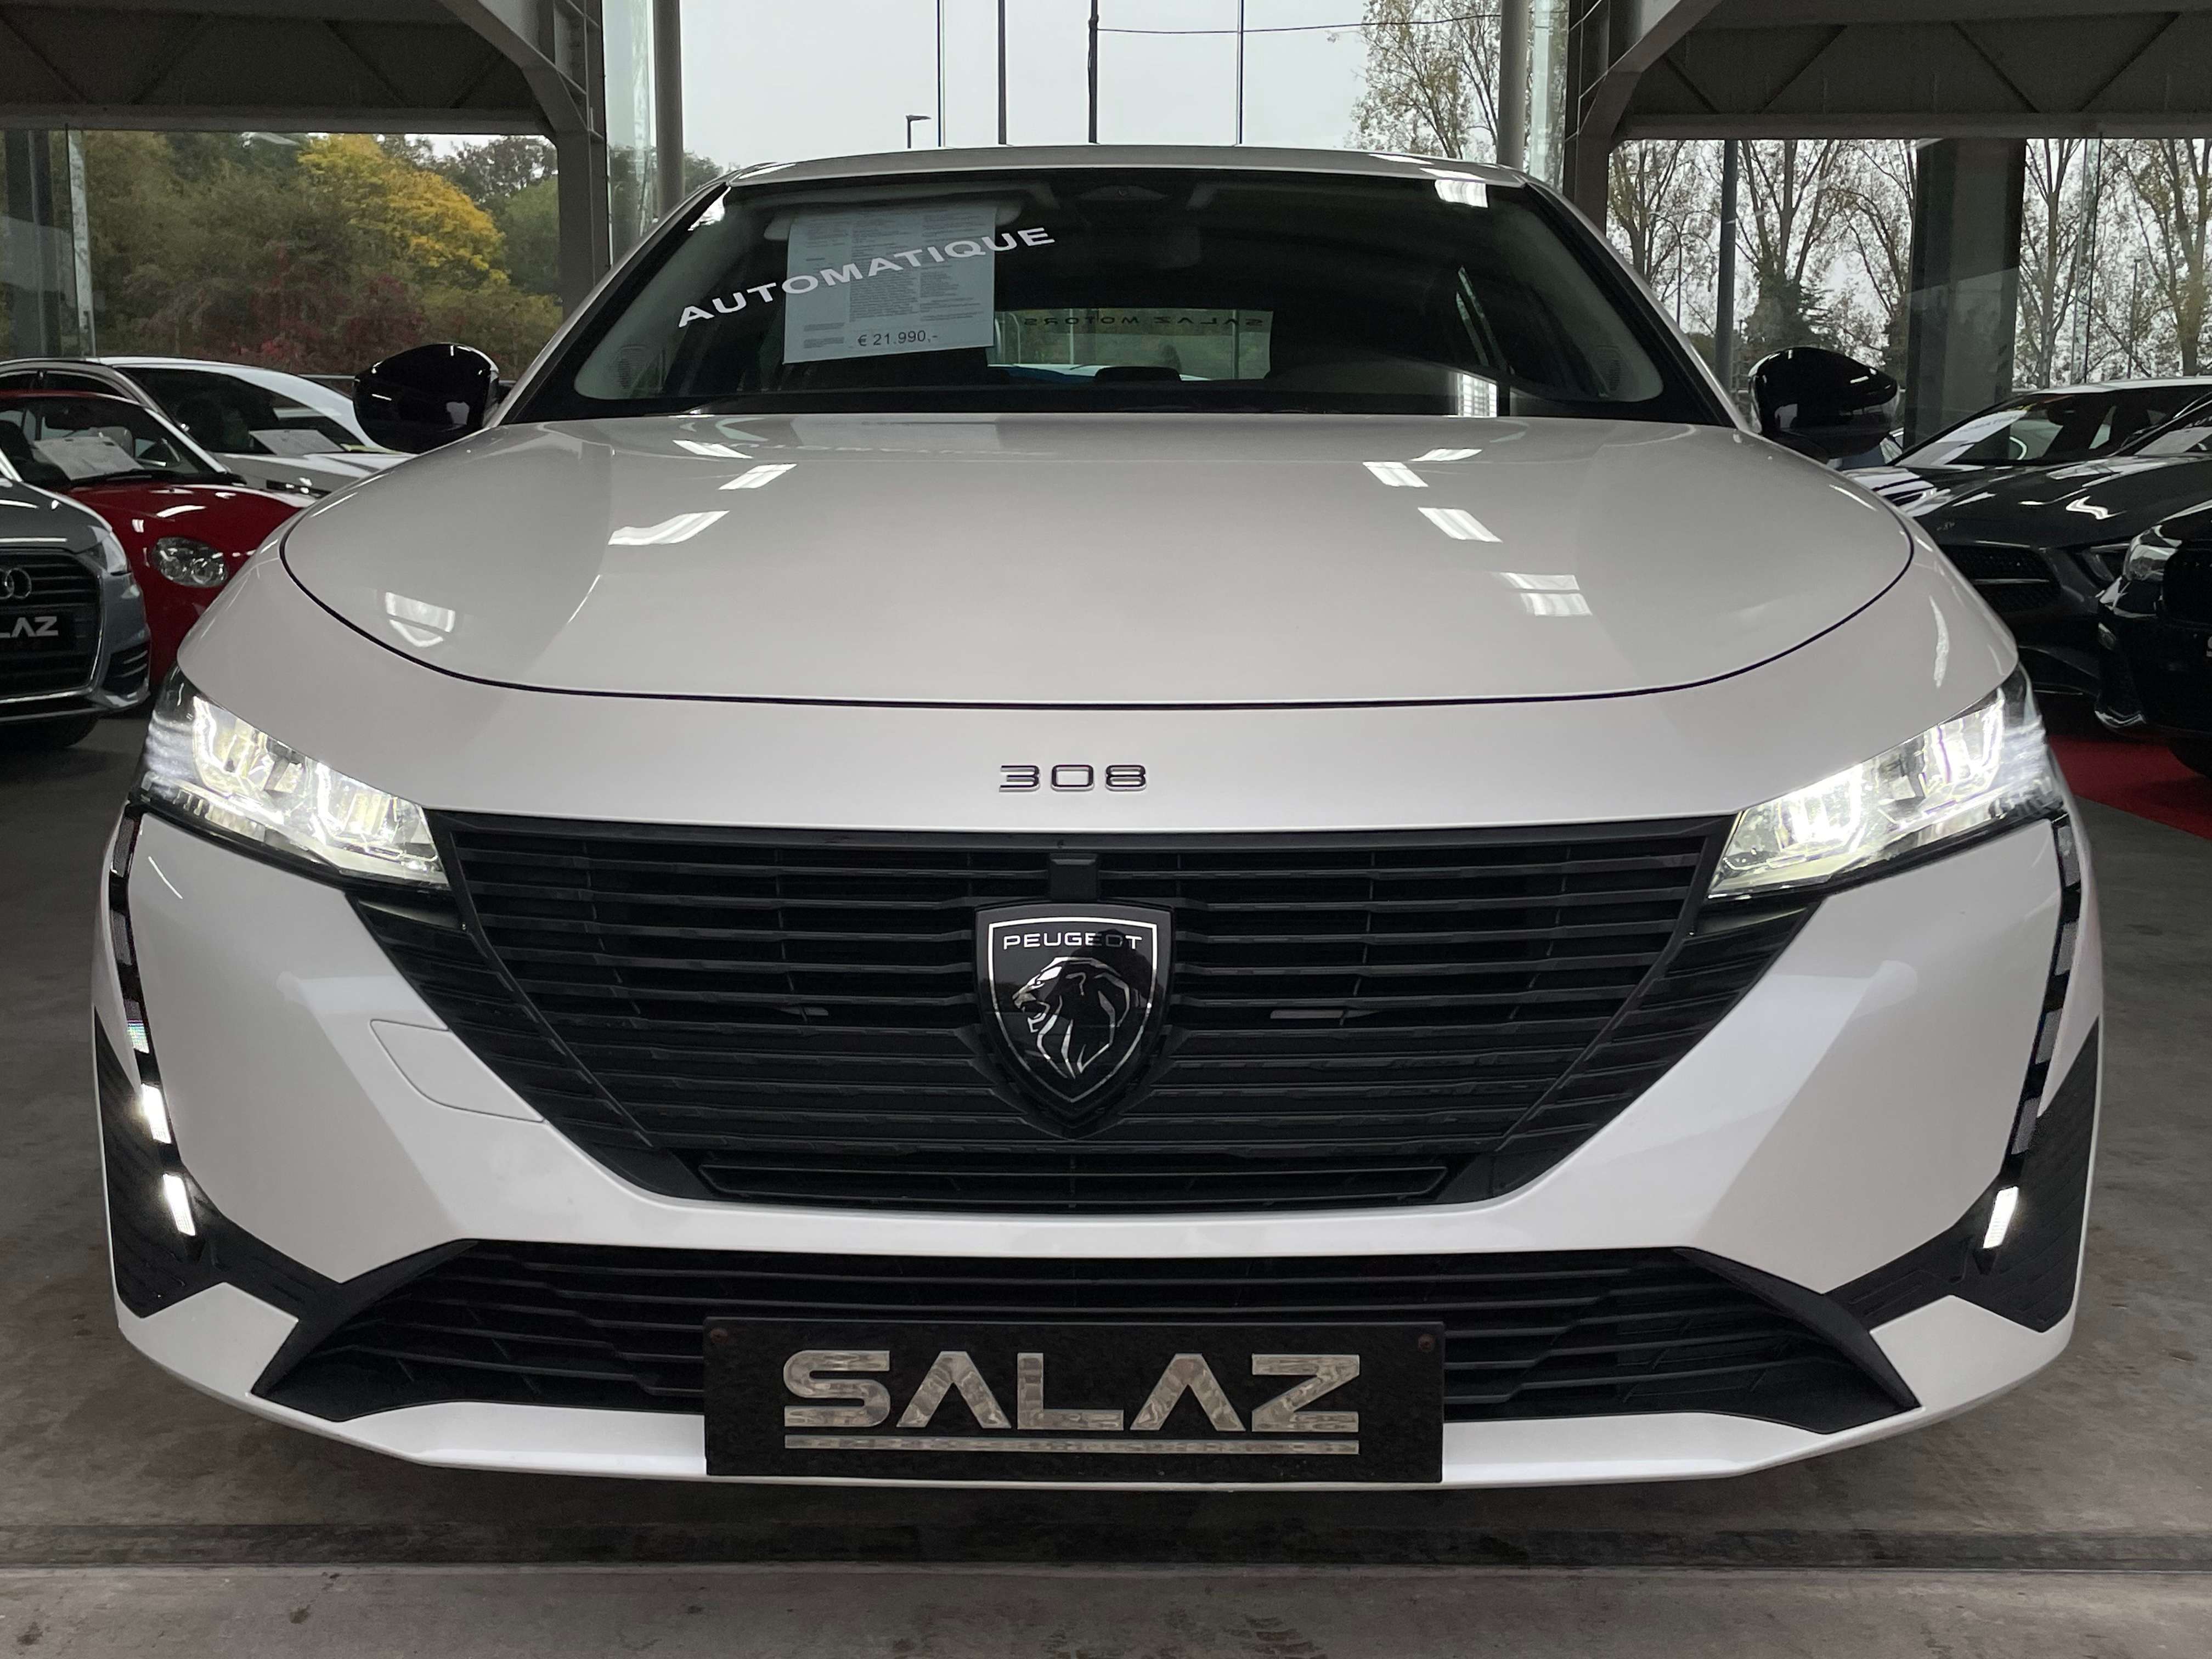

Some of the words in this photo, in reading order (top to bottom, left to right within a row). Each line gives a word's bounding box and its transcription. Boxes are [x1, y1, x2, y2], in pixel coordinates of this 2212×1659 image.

[679, 228, 1055, 328] AUTOMATIQUE
[857, 334, 867, 347] €
[873, 330, 938, 346] 21.990,-
[999, 765, 1147, 792] 308
[1003, 932, 1143, 950] PEUGEOT
[783, 1350, 1360, 1432] SALAZ
